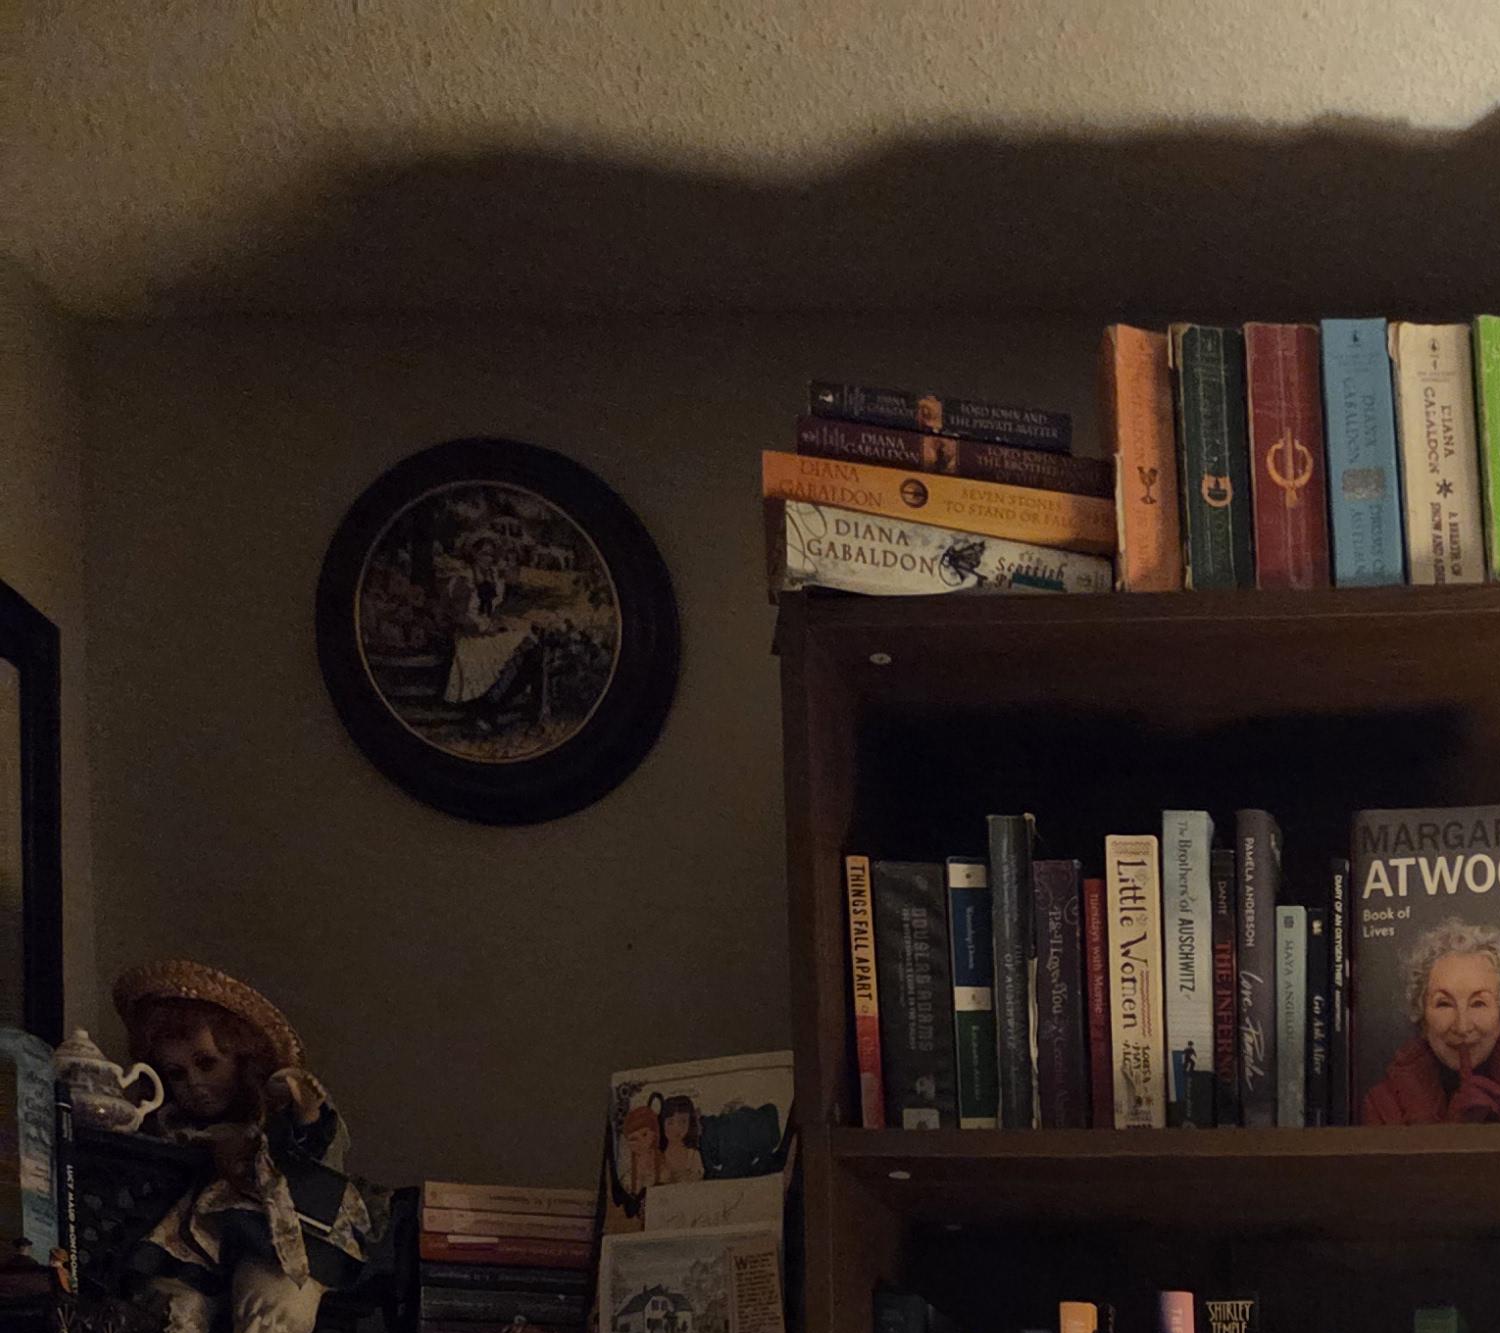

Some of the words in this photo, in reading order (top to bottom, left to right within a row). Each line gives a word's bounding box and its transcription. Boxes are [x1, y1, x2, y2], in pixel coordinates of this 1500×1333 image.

[835, 518, 910, 548] DIANA
[808, 542, 935, 576] GABALDON
[1177, 822, 1187, 838] The
[1177, 839, 1193, 897] Brothers
[1244, 837, 1255, 882] PAMELA
[851, 864, 867, 915] THINGS
[1117, 859, 1147, 927] Little
[1178, 899, 1190, 913] of
[1245, 885, 1255, 947] ANDERSON
[1363, 908, 1392, 922] Book
[1396, 907, 1411, 919] of
[1363, 925, 1396, 938] Lives
[853, 920, 869, 951] FALL
[1178, 918, 1195, 993] AUSCHWITZ
[855, 957, 873, 1001] APART
[1120, 932, 1147, 1029] Women
[1207, 1302, 1251, 1322] SHIRLEY
